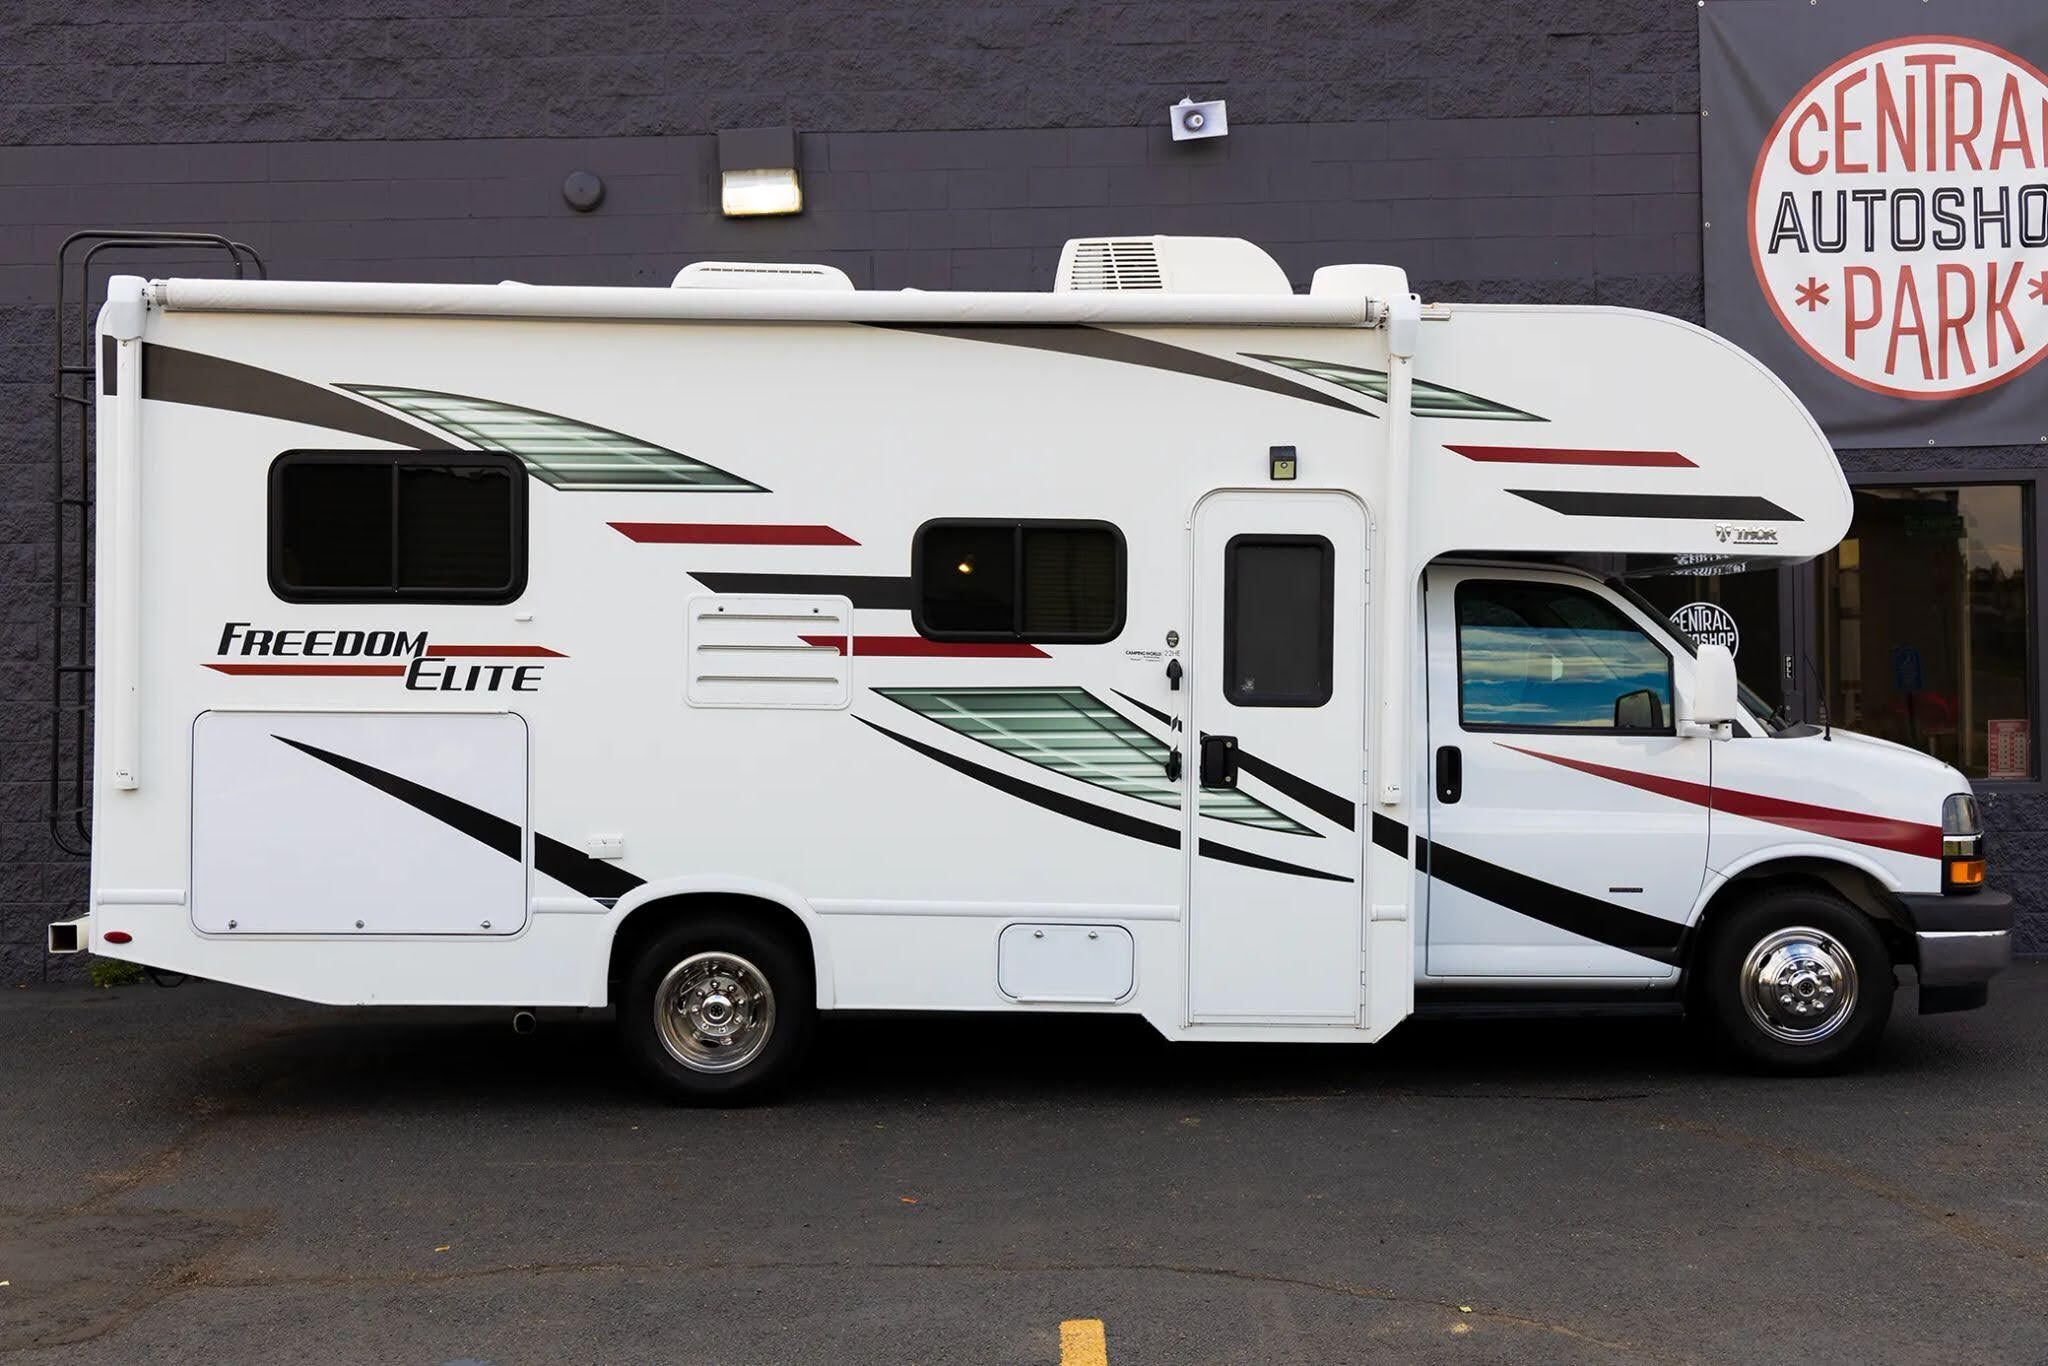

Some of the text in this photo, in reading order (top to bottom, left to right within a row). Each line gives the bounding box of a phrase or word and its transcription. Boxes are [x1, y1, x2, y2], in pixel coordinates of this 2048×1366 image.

[1789, 53, 2048, 175] CENTRA
[1843, 261, 2025, 380] PARK
[1734, 527, 1778, 541] THOR
[217, 622, 428, 657] FREEDOM
[1688, 632, 1735, 647] OSHOP
[405, 657, 545, 691] ELITE
